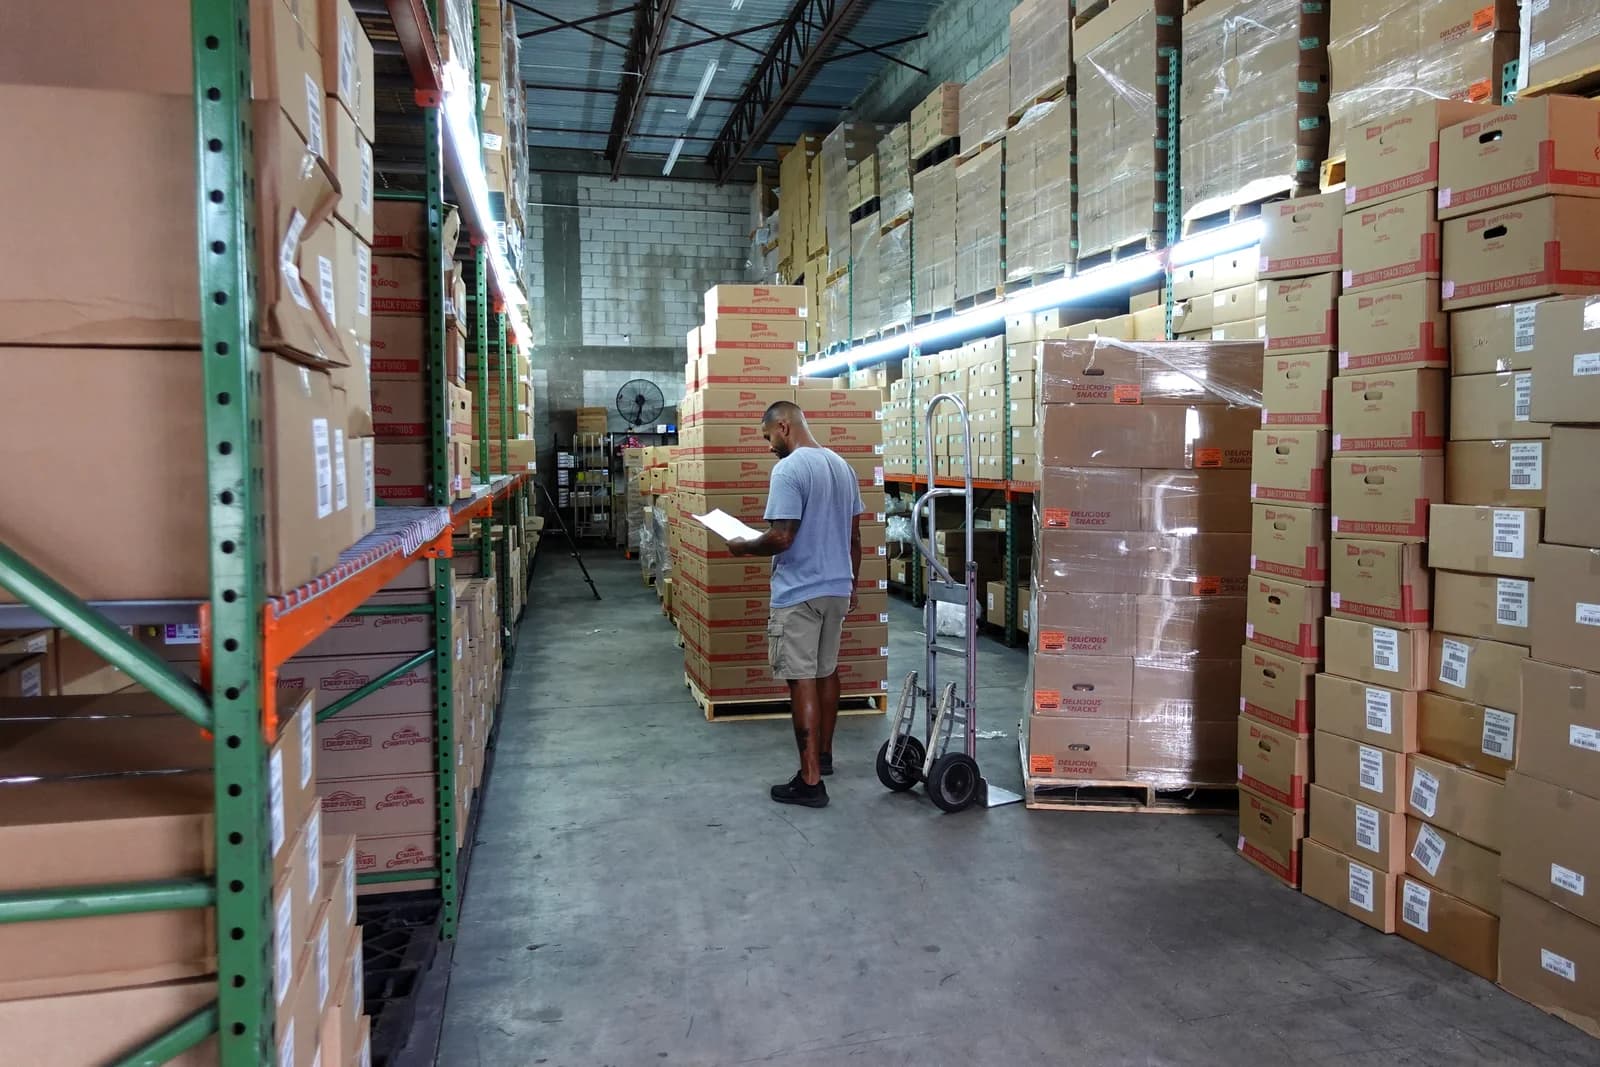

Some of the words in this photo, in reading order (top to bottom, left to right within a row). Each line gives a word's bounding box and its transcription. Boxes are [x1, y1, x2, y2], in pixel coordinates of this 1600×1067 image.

[1368, 184, 1388, 197] QUALITY
[1389, 179, 1406, 192] SNACK
[1407, 173, 1424, 186] FOODS
[1465, 186, 1489, 201] QUALITY
[1490, 180, 1512, 196] SNACK
[1512, 176, 1532, 190] FOODS
[1469, 284, 1494, 298] QUALITY
[1495, 279, 1516, 292] SNACK
[1516, 274, 1536, 288] FOODS
[1229, 457, 1252, 465] SNAC
[346, 738, 369, 746] RIVER
